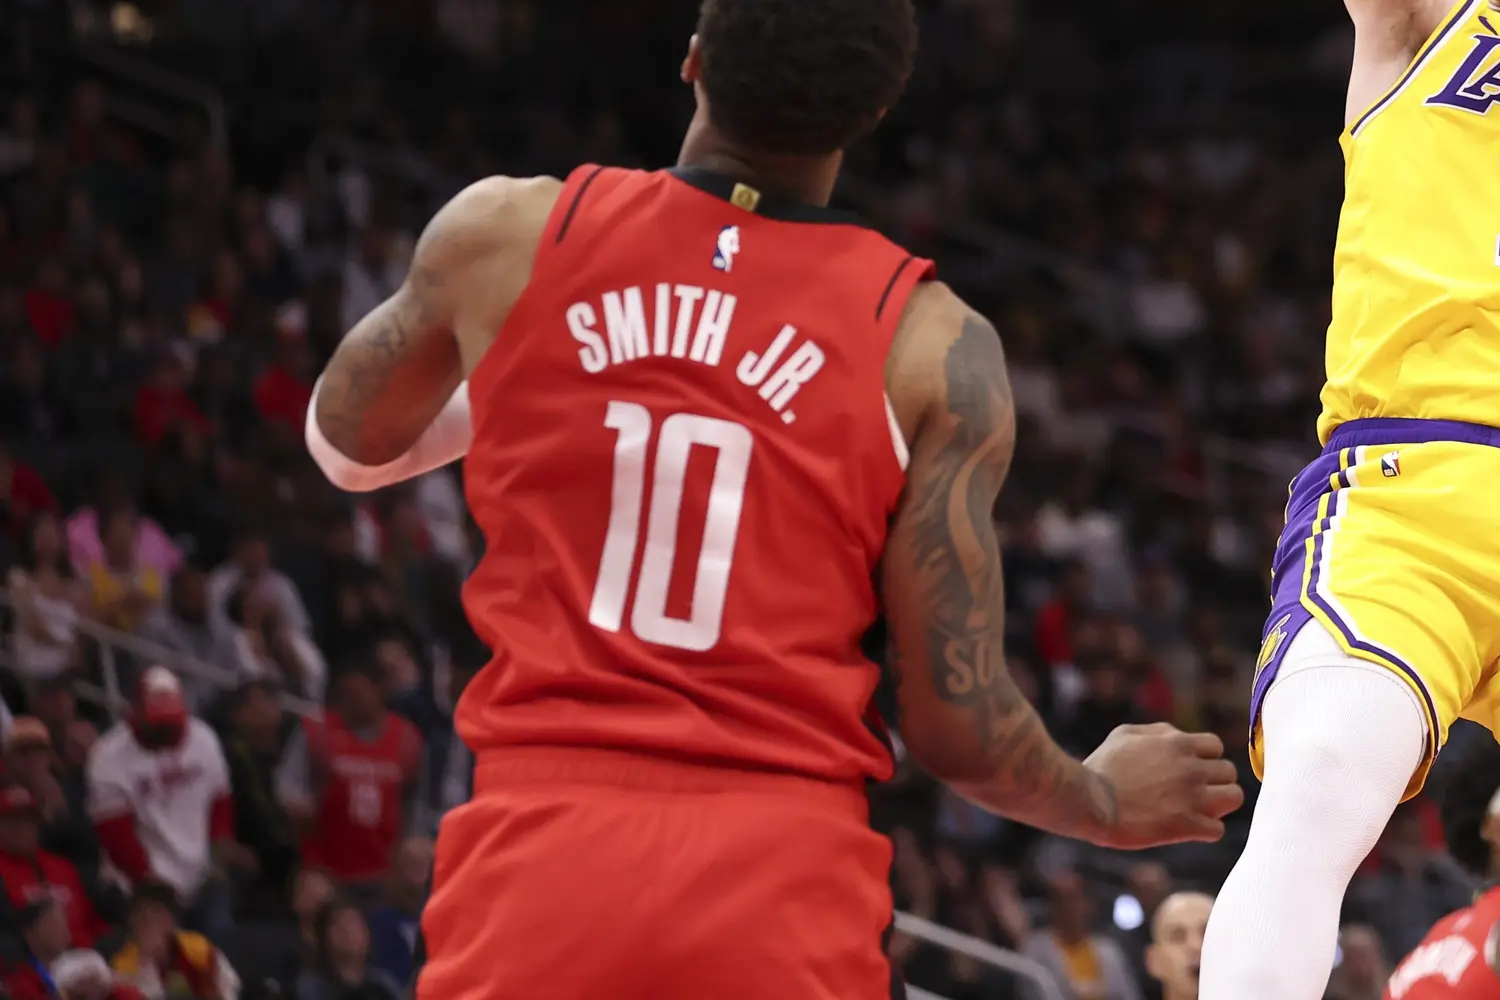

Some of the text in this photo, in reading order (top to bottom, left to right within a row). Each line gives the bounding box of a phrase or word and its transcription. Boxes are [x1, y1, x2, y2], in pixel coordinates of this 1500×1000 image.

[566, 283, 826, 424] SMITH JR.
[589, 400, 753, 651] 10
